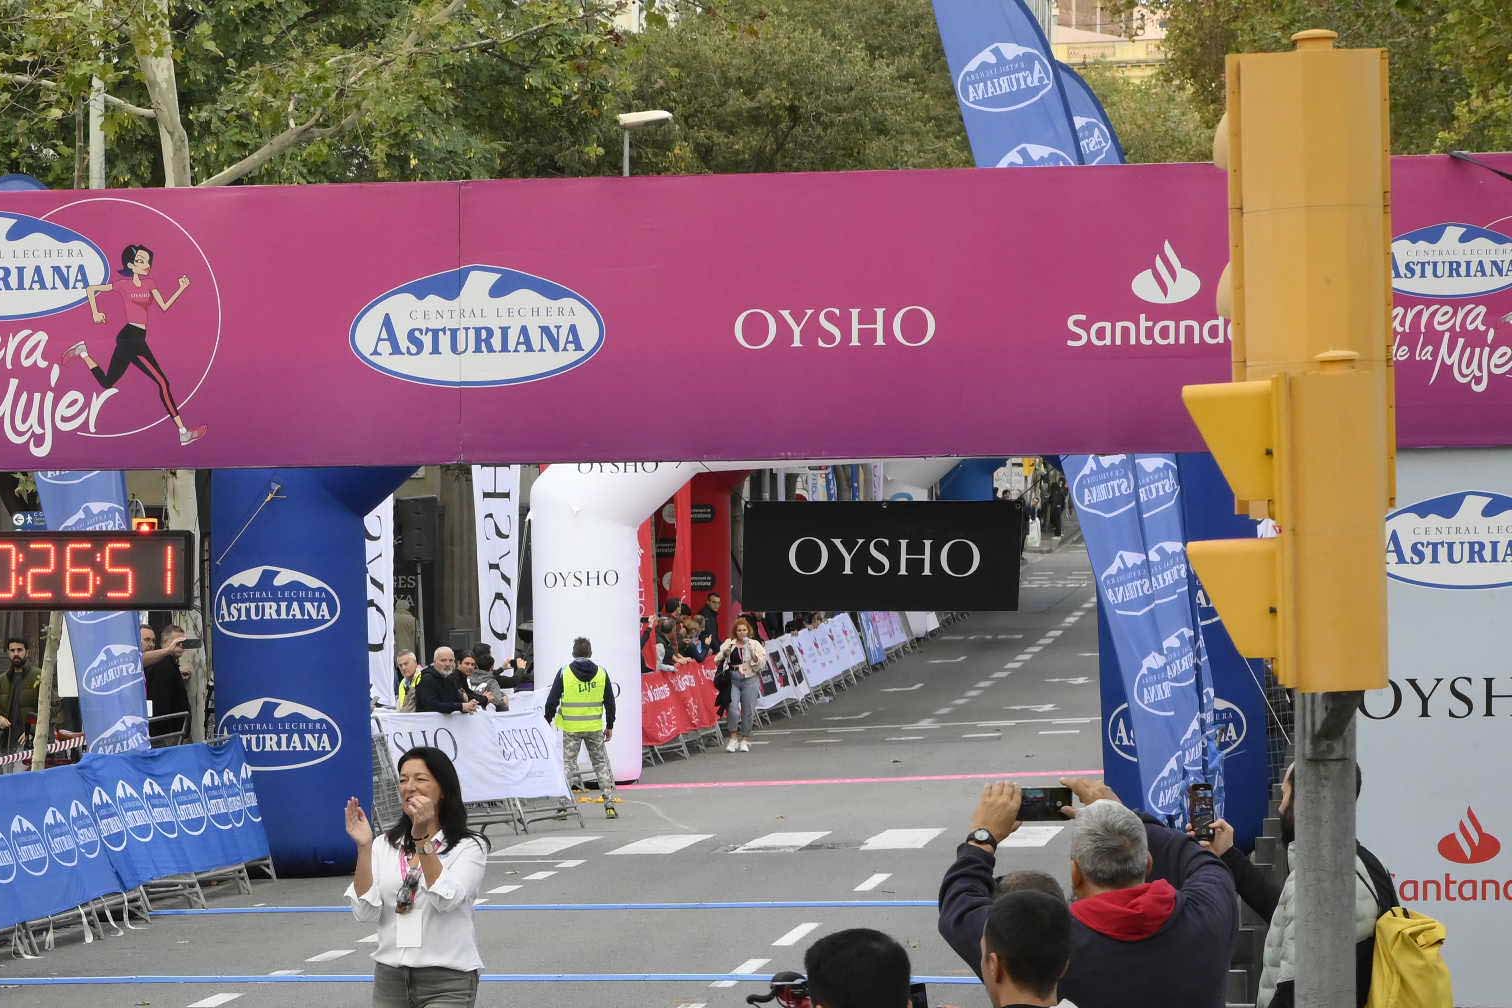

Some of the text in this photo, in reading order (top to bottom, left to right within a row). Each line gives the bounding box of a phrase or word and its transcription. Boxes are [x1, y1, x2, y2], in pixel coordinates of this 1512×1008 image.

[12, 248, 86, 259] LECHERA
[409, 305, 577, 321] CENTRAL LECHERA
[1391, 303, 1488, 333] arrera
[369, 312, 586, 357] ASTURIANA
[733, 304, 937, 350] OYSHO
[1415, 333, 1433, 361] la
[1412, 526, 1481, 536] CENTRAL
[788, 535, 982, 578] OYSHO
[543, 569, 619, 589] OYSHO
[230, 590, 327, 600] CENTRAL LECHERA
[218, 595, 331, 623] ASTURIANA
[278, 721, 328, 730] LECHERA
[240, 733, 332, 752] TURIANA
[1392, 872, 1512, 902] antan
